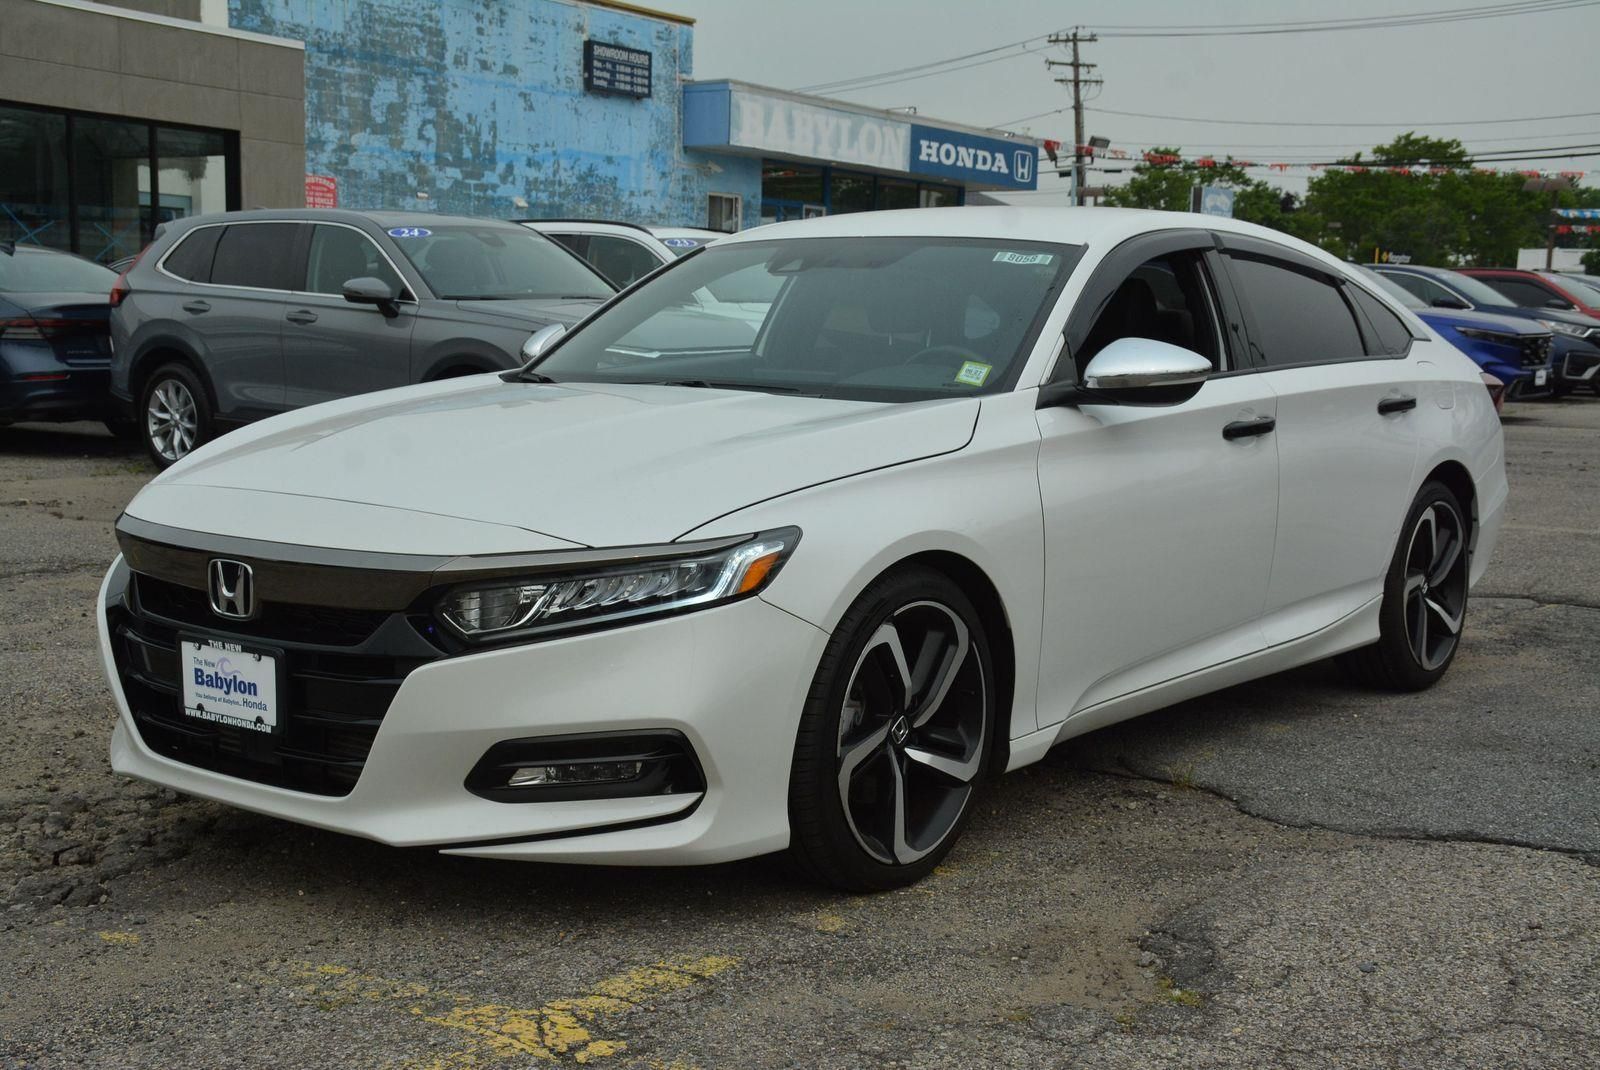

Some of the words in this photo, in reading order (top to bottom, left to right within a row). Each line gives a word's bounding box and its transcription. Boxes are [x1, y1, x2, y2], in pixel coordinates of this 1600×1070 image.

[593, 45, 628, 61] SHOWROOM
[629, 52, 649, 66] HOURS
[739, 98, 908, 168] BABYLON
[919, 139, 1009, 174] HONDA
[401, 228, 418, 237] 24
[208, 640, 223, 650] THE
[224, 642, 242, 652] NEW
[193, 656, 203, 666] The
[204, 659, 216, 668] New
[194, 667, 258, 696] Babylon
[242, 698, 268, 711] Honda
[184, 707, 272, 733] WWW.BABYLONHONDA.COM
